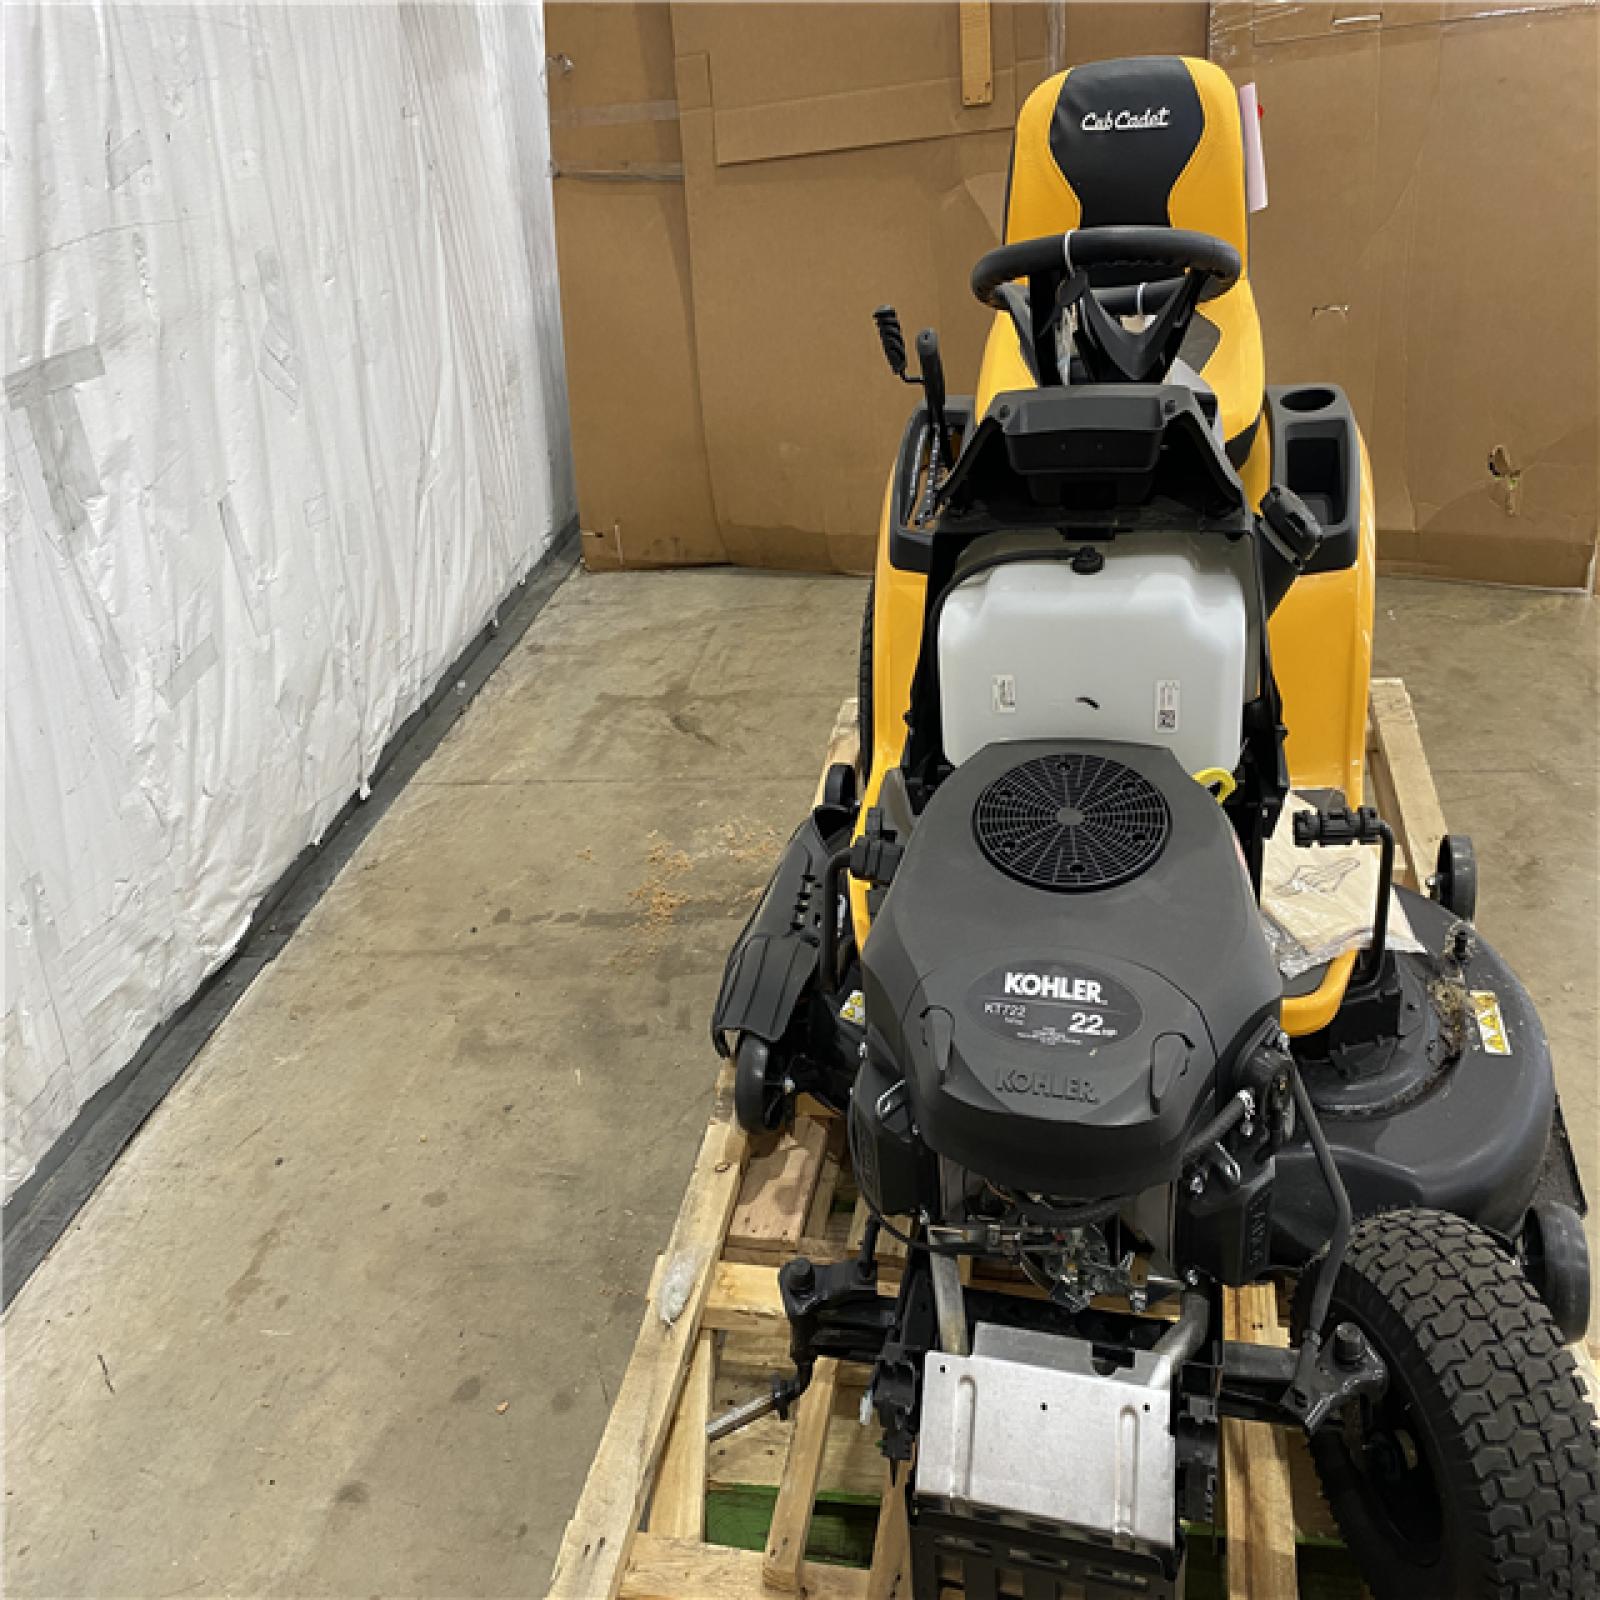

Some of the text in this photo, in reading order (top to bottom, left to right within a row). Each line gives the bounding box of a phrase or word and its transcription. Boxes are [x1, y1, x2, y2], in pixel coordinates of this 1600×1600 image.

[1081, 106, 1171, 131] Cub Cadet
[1004, 971, 1104, 1004] KOHLER
[1067, 1011, 1103, 1036] 22
[994, 1067, 1098, 1104] KOHLER
